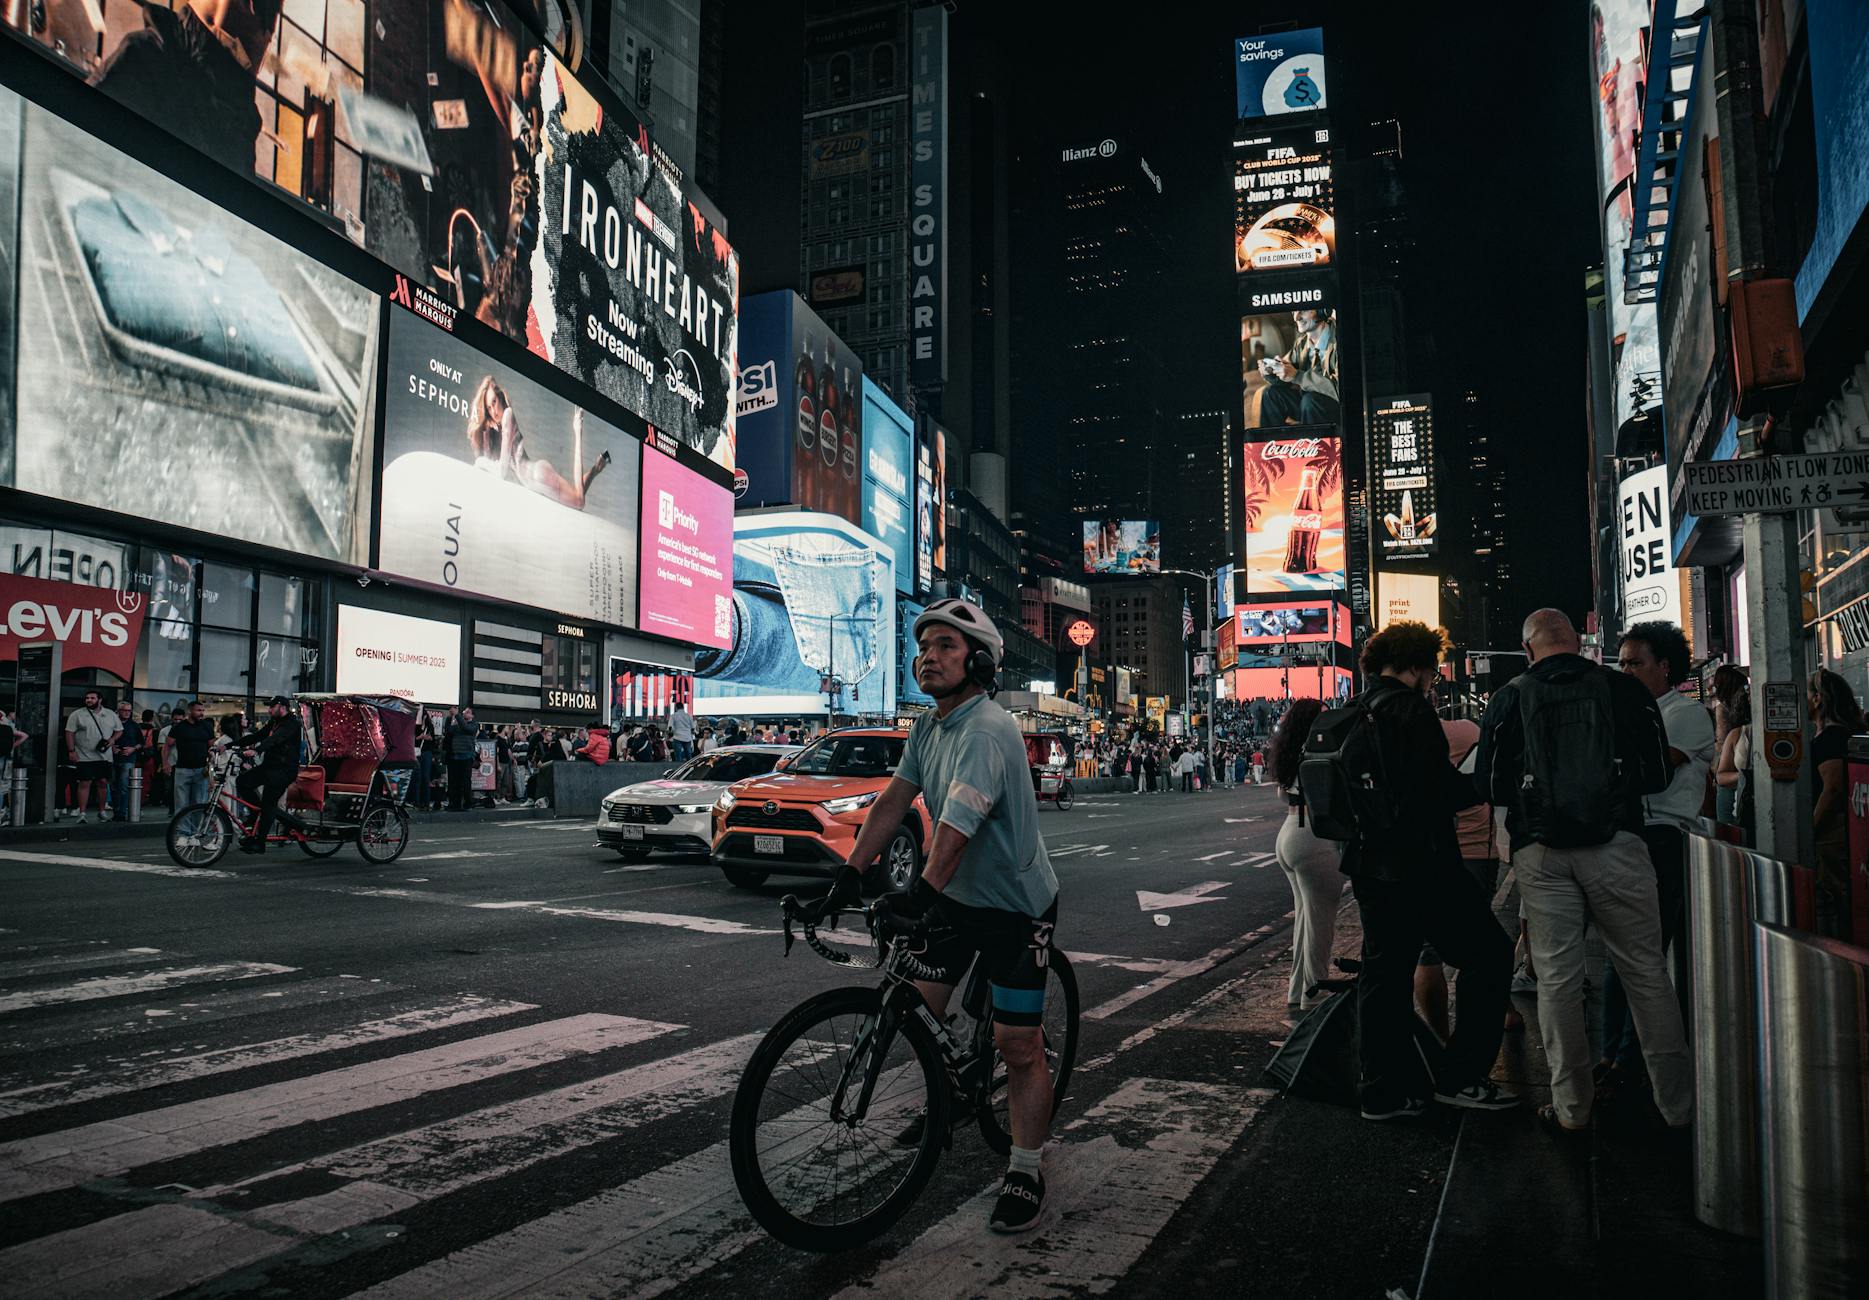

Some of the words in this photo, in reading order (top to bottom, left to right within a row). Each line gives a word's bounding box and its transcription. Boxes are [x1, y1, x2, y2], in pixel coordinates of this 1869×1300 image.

[1240, 39, 1266, 52] Your
[1240, 47, 1284, 62] savings
[914, 26, 936, 162] TIMES
[1243, 161, 1261, 170] CLUB
[1262, 159, 1287, 168] WORLD
[1287, 157, 1301, 165] CUP
[1267, 147, 1297, 160] FIFA
[1234, 174, 1256, 190] BUY
[1258, 169, 1302, 187] TICKETS
[1304, 165, 1330, 183] NOW
[1247, 190, 1271, 203] June
[1292, 185, 1314, 198] July
[1315, 184, 1321, 196] 1
[562, 163, 724, 361] IRONHEART
[912, 183, 936, 361] SQUARE
[415, 287, 458, 319] MARRIOTT
[1251, 289, 1322, 307] SAMSUNG
[414, 302, 454, 329] MARQUIS
[608, 300, 638, 341] Now
[587, 314, 655, 385] Streaming
[429, 358, 451, 379] ONLY
[452, 371, 463, 385] AT
[1391, 400, 1411, 409] FIFA
[1393, 420, 1413, 434] THE
[1261, 438, 1321, 460] Coca-Cola
[1391, 433, 1416, 449] BEST
[1391, 447, 1418, 462] FANS
[1410, 466, 1422, 475] July
[1688, 461, 1783, 486] PEDESTRIAN
[1786, 458, 1828, 479] FLOW
[1691, 491, 1729, 511] KEEP
[1734, 486, 1793, 509] MOVING
[674, 505, 699, 536] Priority
[1621, 486, 1662, 539] EN
[443, 502, 462, 586] OUAI
[658, 532, 682, 551] America's
[699, 551, 717, 565] network
[657, 549, 683, 567] experience
[700, 565, 723, 581] responders
[1389, 598, 1410, 608] print
[1389, 608, 1408, 616] your
[0, 600, 129, 647] evi's
[557, 624, 585, 638] SEPHORA
[355, 647, 392, 661] OPENING
[398, 651, 429, 667] SUMMER
[430, 655, 446, 668] 2025
[548, 690, 597, 710] SEPHORA
